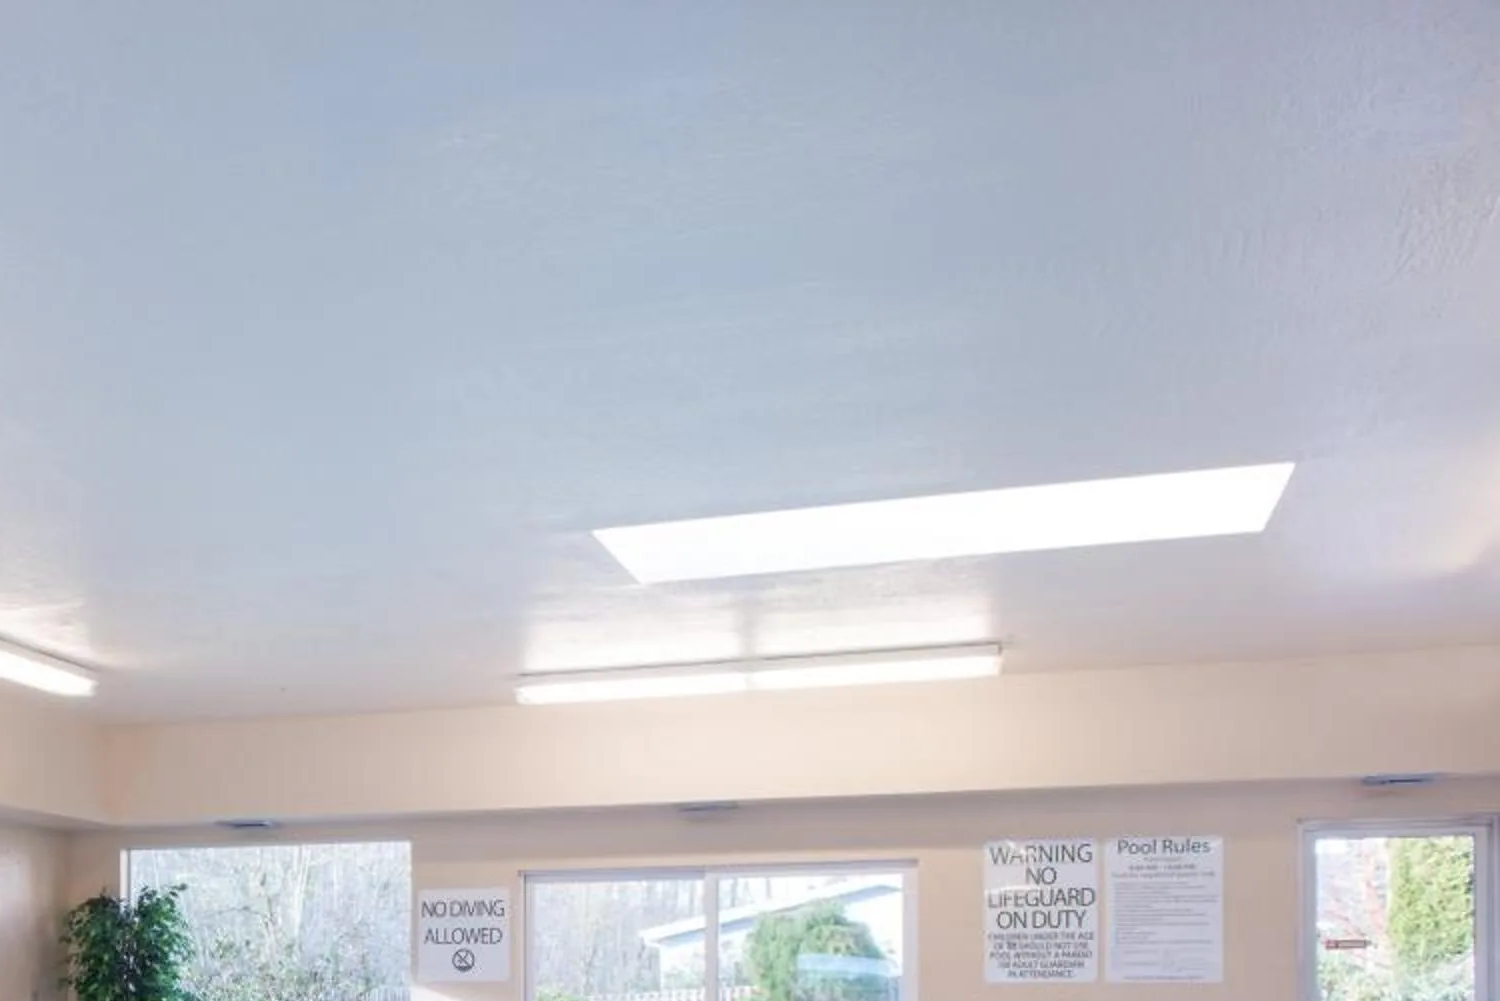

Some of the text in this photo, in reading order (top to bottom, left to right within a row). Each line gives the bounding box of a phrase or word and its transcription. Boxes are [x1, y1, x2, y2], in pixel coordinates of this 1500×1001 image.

[989, 843, 1093, 864] WARNING
[1117, 838, 1211, 854] Pool Rules
[1025, 866, 1057, 885] NO
[987, 887, 1096, 908] LIFEGUARD
[421, 899, 505, 917] NO DIVING
[996, 909, 1087, 929] ON DUTY
[423, 927, 503, 945] ALLOWED
